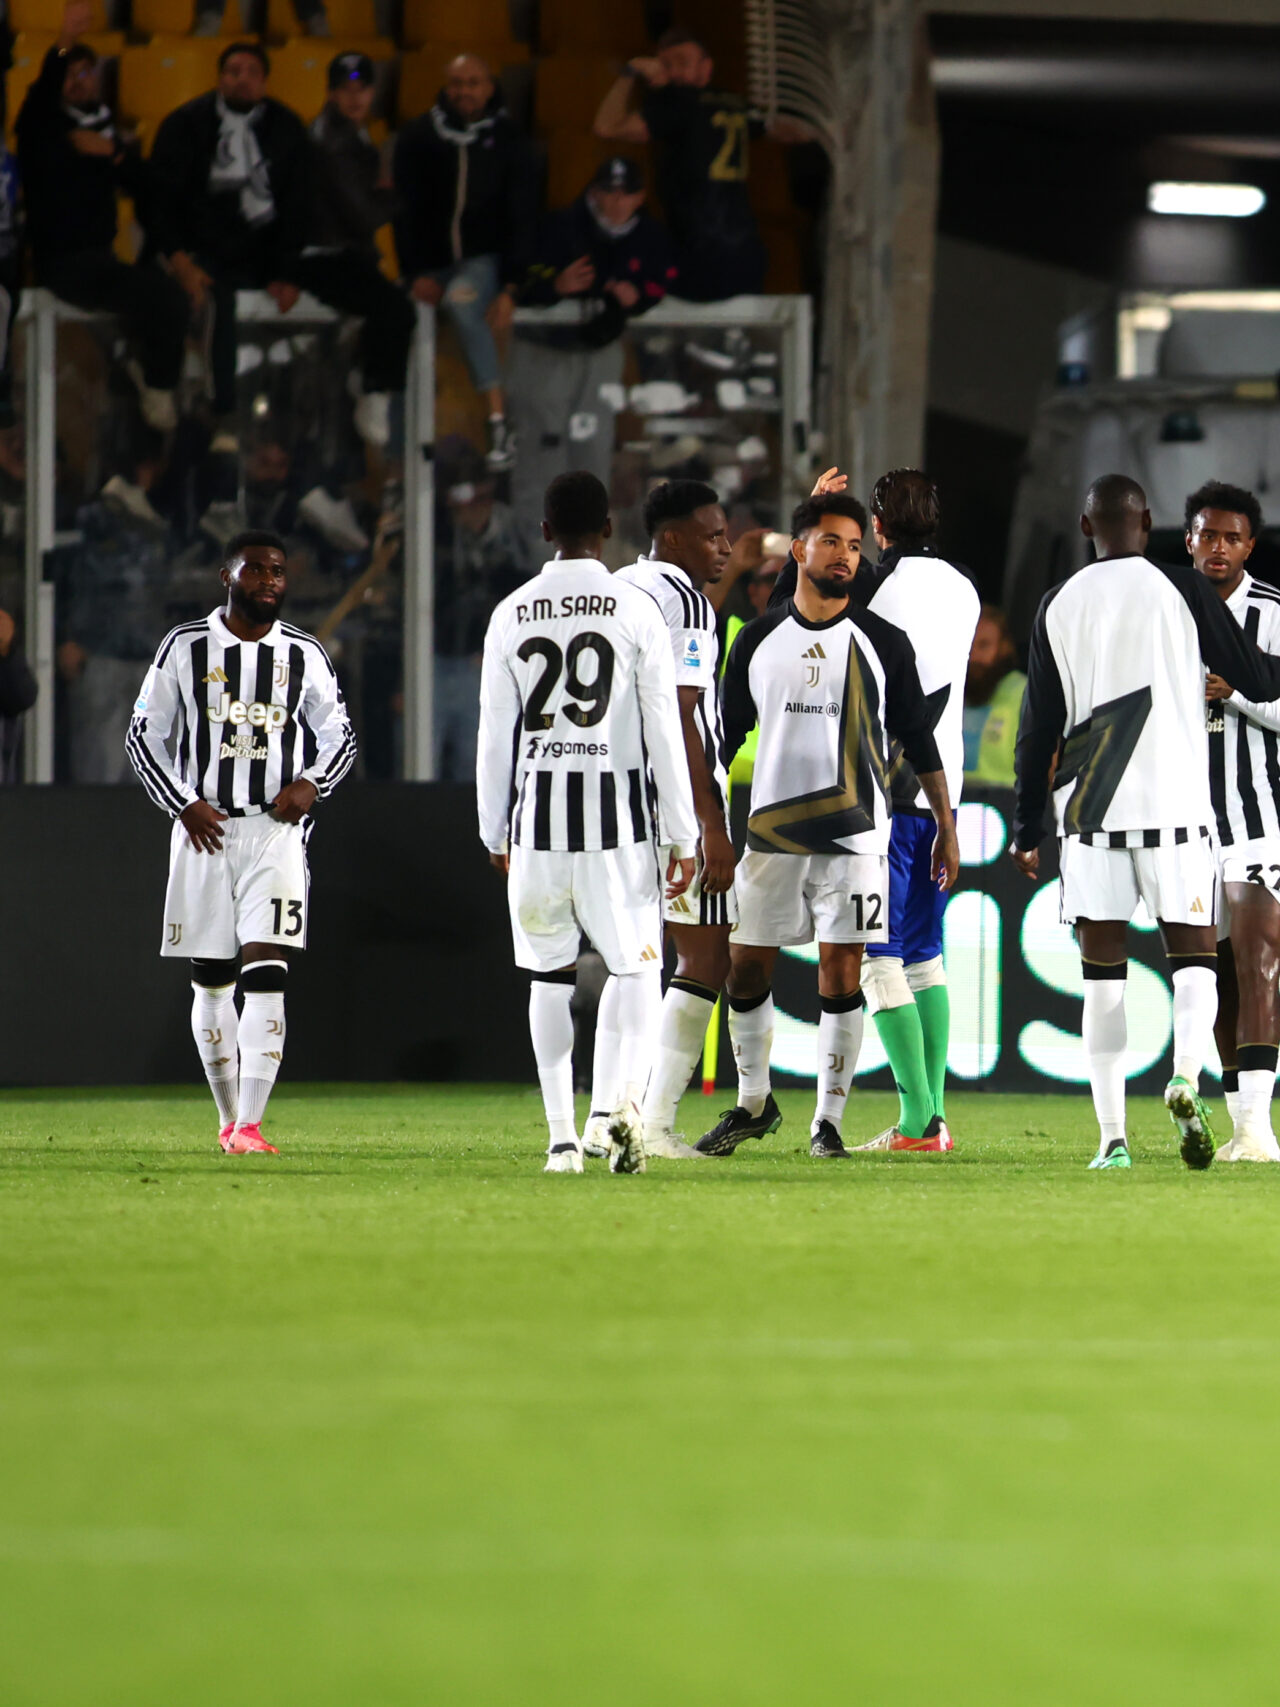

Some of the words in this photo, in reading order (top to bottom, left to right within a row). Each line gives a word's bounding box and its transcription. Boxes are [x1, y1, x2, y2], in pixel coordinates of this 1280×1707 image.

[517, 631, 615, 732] 29
[206, 692, 288, 733] Jeep
[784, 702, 823, 714] Allianz
[230, 734, 258, 747] VISIT
[540, 740, 609, 759] ygames
[270, 898, 303, 937] 13
[850, 892, 883, 931] 12
